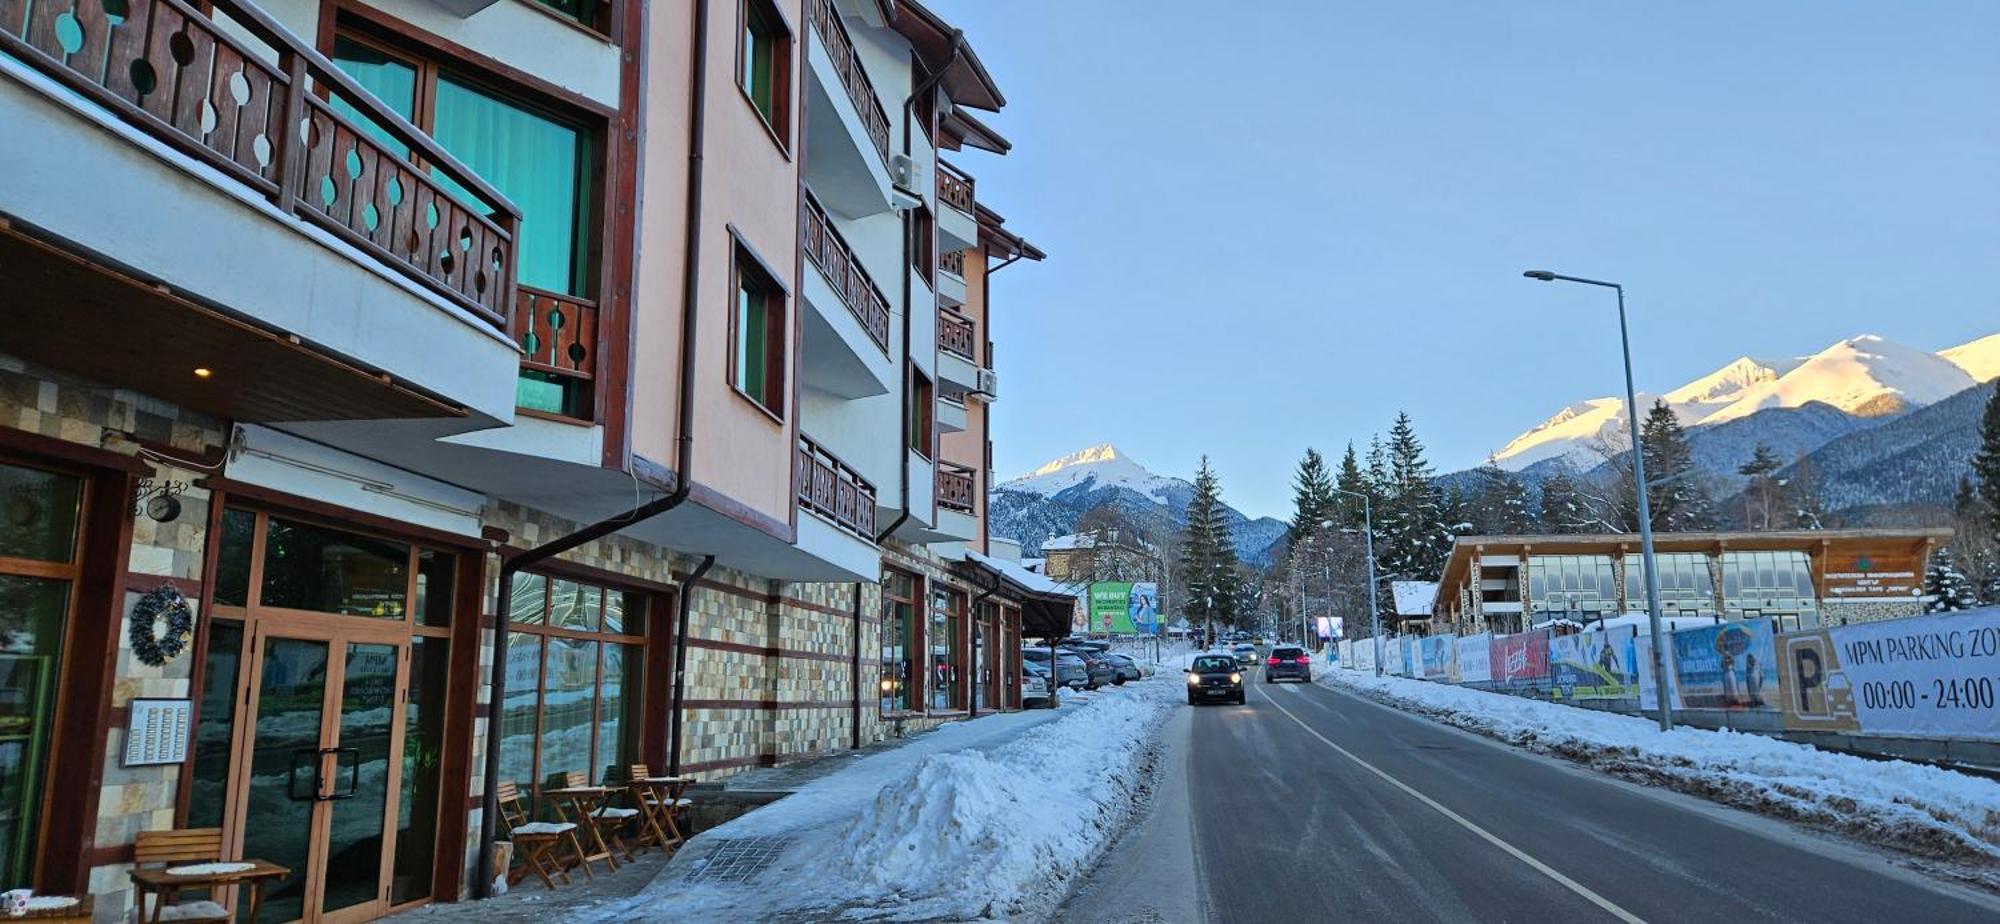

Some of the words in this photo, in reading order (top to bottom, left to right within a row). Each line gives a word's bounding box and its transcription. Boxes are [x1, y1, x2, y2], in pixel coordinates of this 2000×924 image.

[1844, 641, 1885, 666] MPM
[1886, 631, 1964, 662] PARKING
[1968, 627, 2000, 657] ZO
[1796, 647, 1822, 712] P
[1863, 680, 1916, 709] 00:00
[1933, 677, 1994, 709] 24:00
